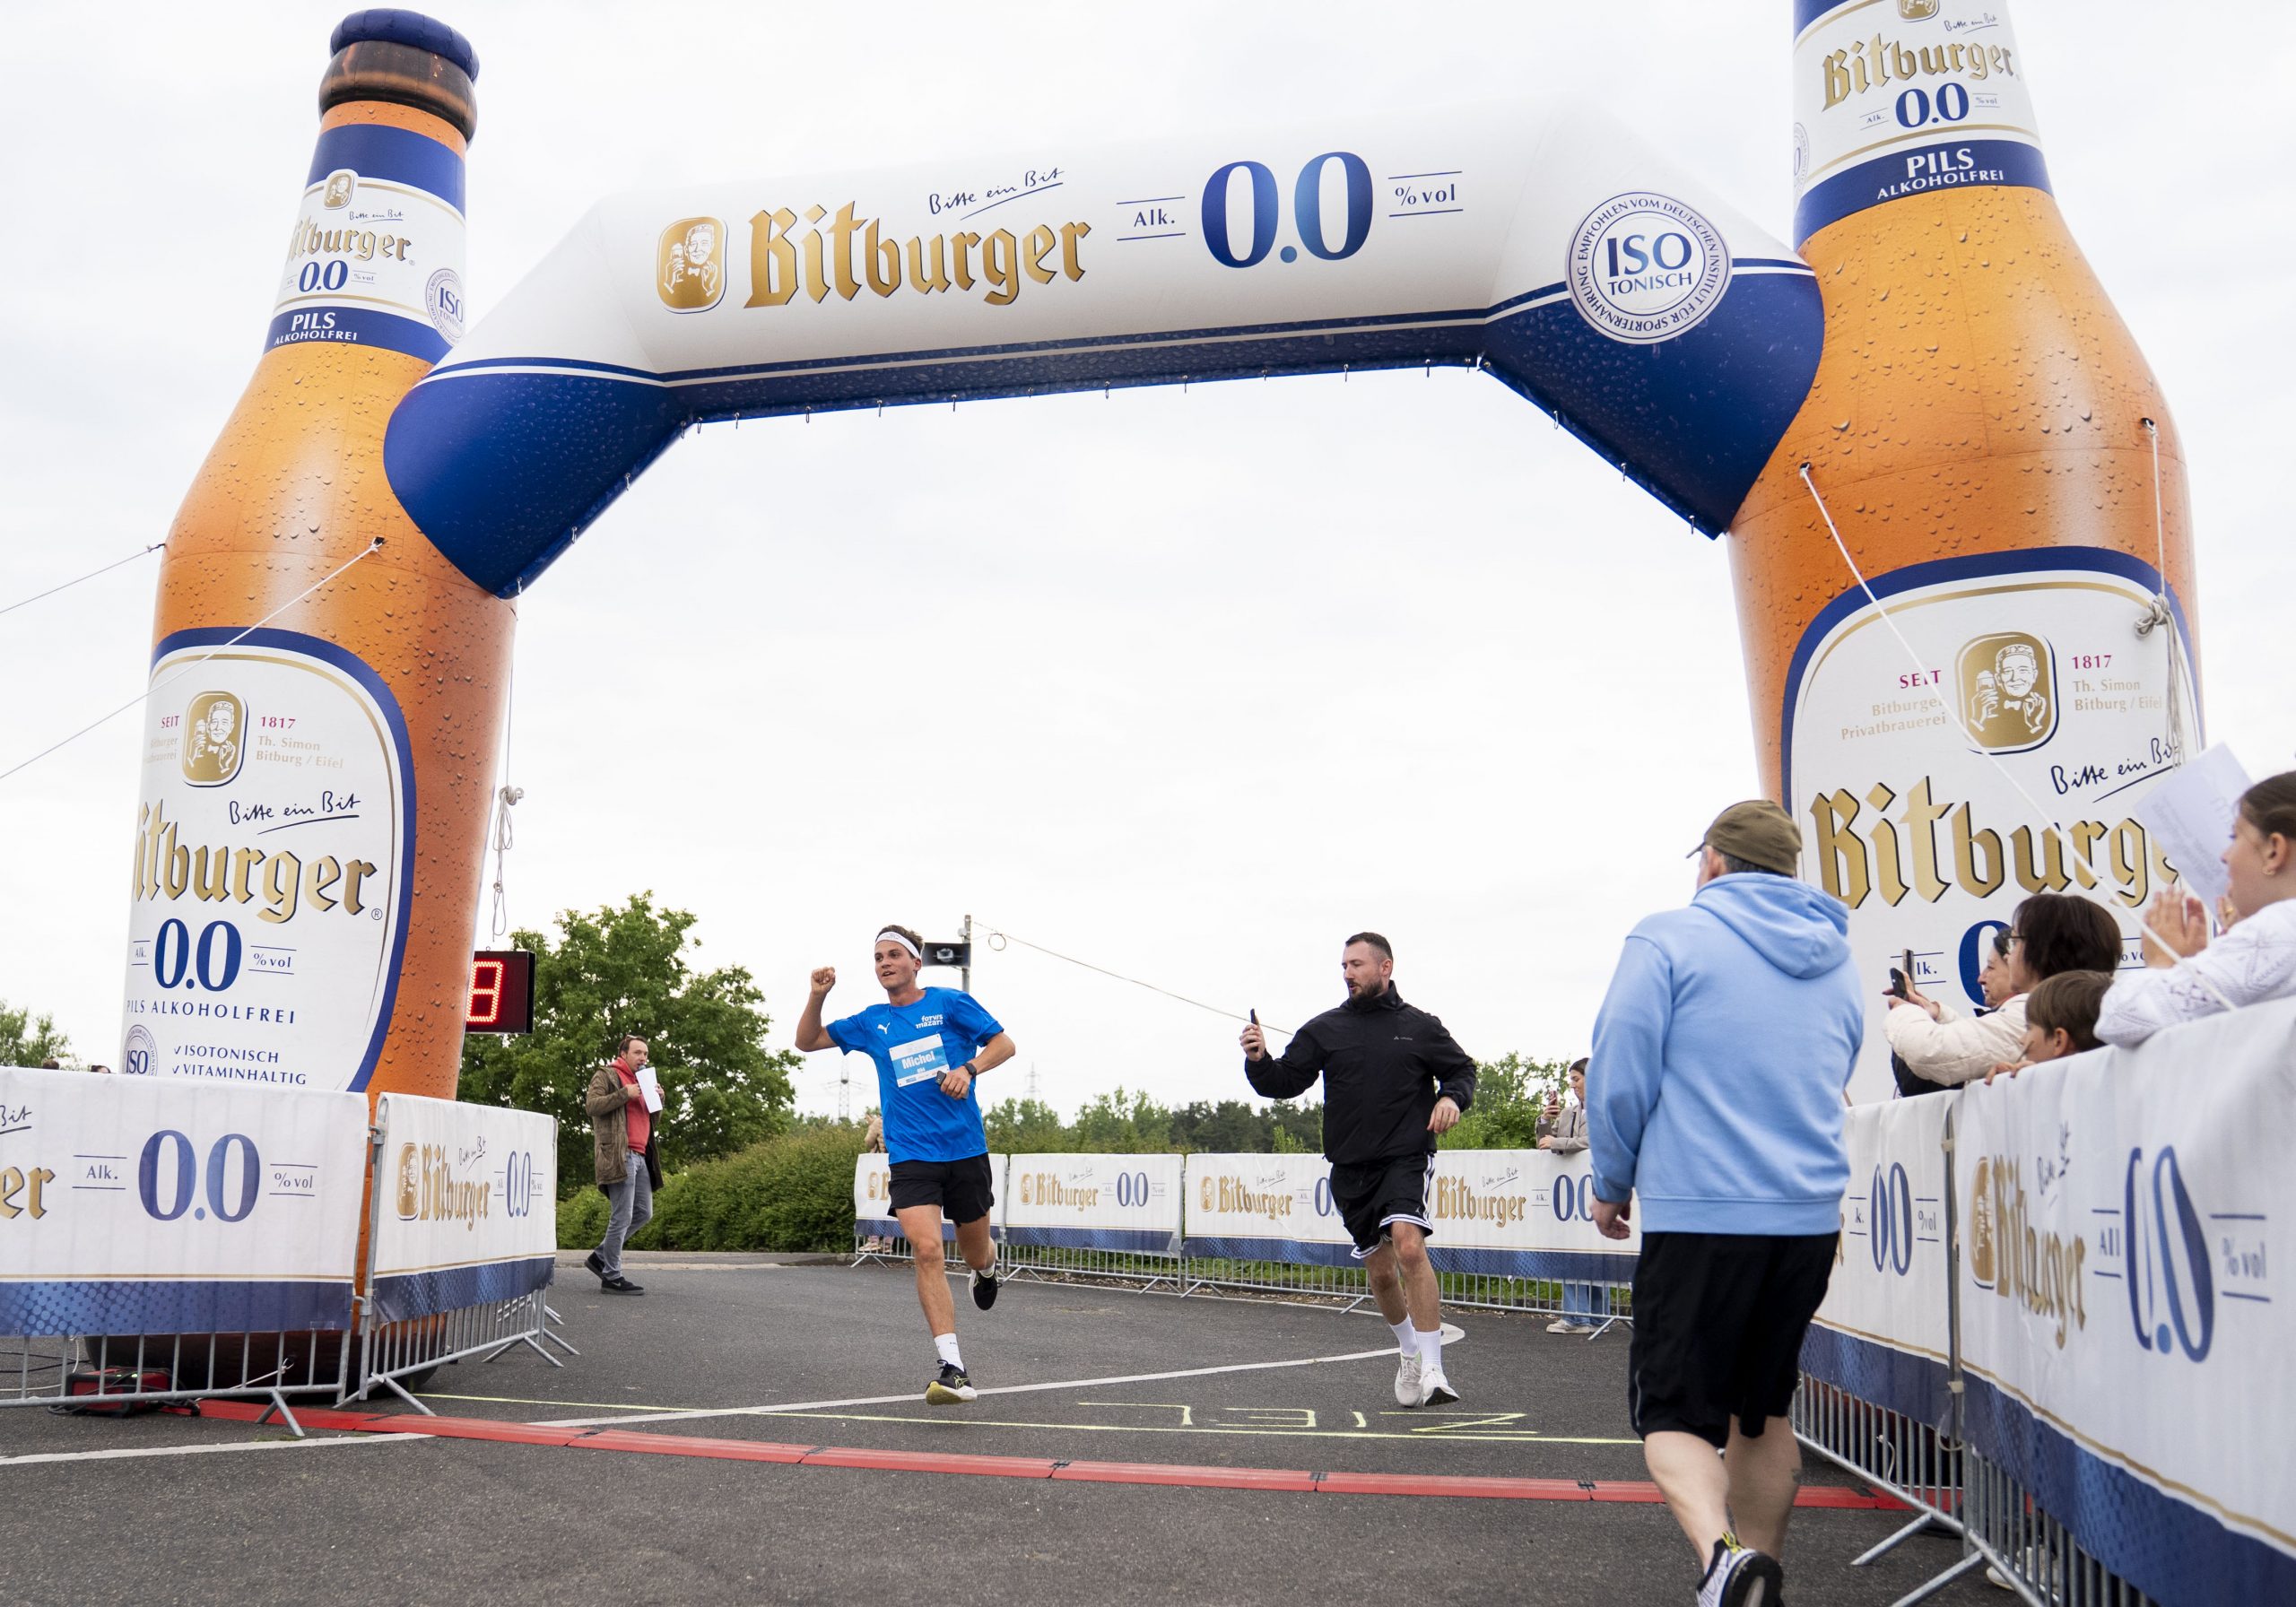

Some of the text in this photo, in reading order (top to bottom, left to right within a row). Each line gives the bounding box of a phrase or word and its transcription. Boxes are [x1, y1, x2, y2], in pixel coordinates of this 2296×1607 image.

[1822, 33, 2013, 112] Bitburger
[1895, 83, 1970, 128] 0.0
[1907, 148, 1974, 178] PILS
[929, 168, 1065, 215] Bitte ein Bit
[1877, 169, 2004, 200] ALKOHOLFREI
[743, 200, 1091, 308] Bitburger
[1134, 208, 1176, 228] Alk.
[1201, 152, 1373, 268] 0.0
[1577, 198, 1719, 331] EMPFOHLEN VOM DEUTSCHEN INSTITUT FÜR SPORTERNÄHRUNG
[1607, 232, 1692, 277] ISO
[299, 260, 349, 292] 0.0
[1607, 272, 1692, 295] TONISCH
[439, 287, 464, 323] ISO
[274, 329, 358, 346] ALKOHOLFREI
[291, 312, 336, 332] PILS
[2072, 655, 2111, 669] 1817
[2073, 679, 2141, 692] Th. Simon
[2074, 697, 2127, 713] Bitburg
[2138, 696, 2162, 709] Eifel
[161, 715, 180, 728] SEIT
[260, 716, 296, 729] 1817
[1841, 712, 1946, 740] Privatbrauerei
[257, 735, 320, 751] Th. Simon
[256, 750, 302, 767] Bitburg
[315, 756, 344, 769] Eifel
[2050, 764, 2109, 795] Bitte
[2118, 758, 2147, 777] ein
[229, 790, 361, 824] Bitte ein Bit
[1810, 776, 2179, 909] Bitburg
[134, 799, 378, 924] itburger
[154, 917, 242, 992] 0.0
[1917, 960, 1938, 977] lk.
[126, 999, 294, 1024] PILS ALKOHOLFREI
[126, 1050, 148, 1074] ISO
[184, 1045, 279, 1064] ISOTONISCH
[901, 1051, 935, 1070] Michel
[183, 1064, 307, 1085] VITAMINHALTIG
[86, 1164, 118, 1180] Alk.
[138, 1129, 261, 1222] 0.0
[507, 1151, 531, 1218] 0.0
[1036, 1172, 1098, 1212] Bitburger
[1117, 1172, 1149, 1207] 0.0
[1218, 1176, 1292, 1220] Bitburger
[1435, 1176, 1526, 1228] Bitburger
